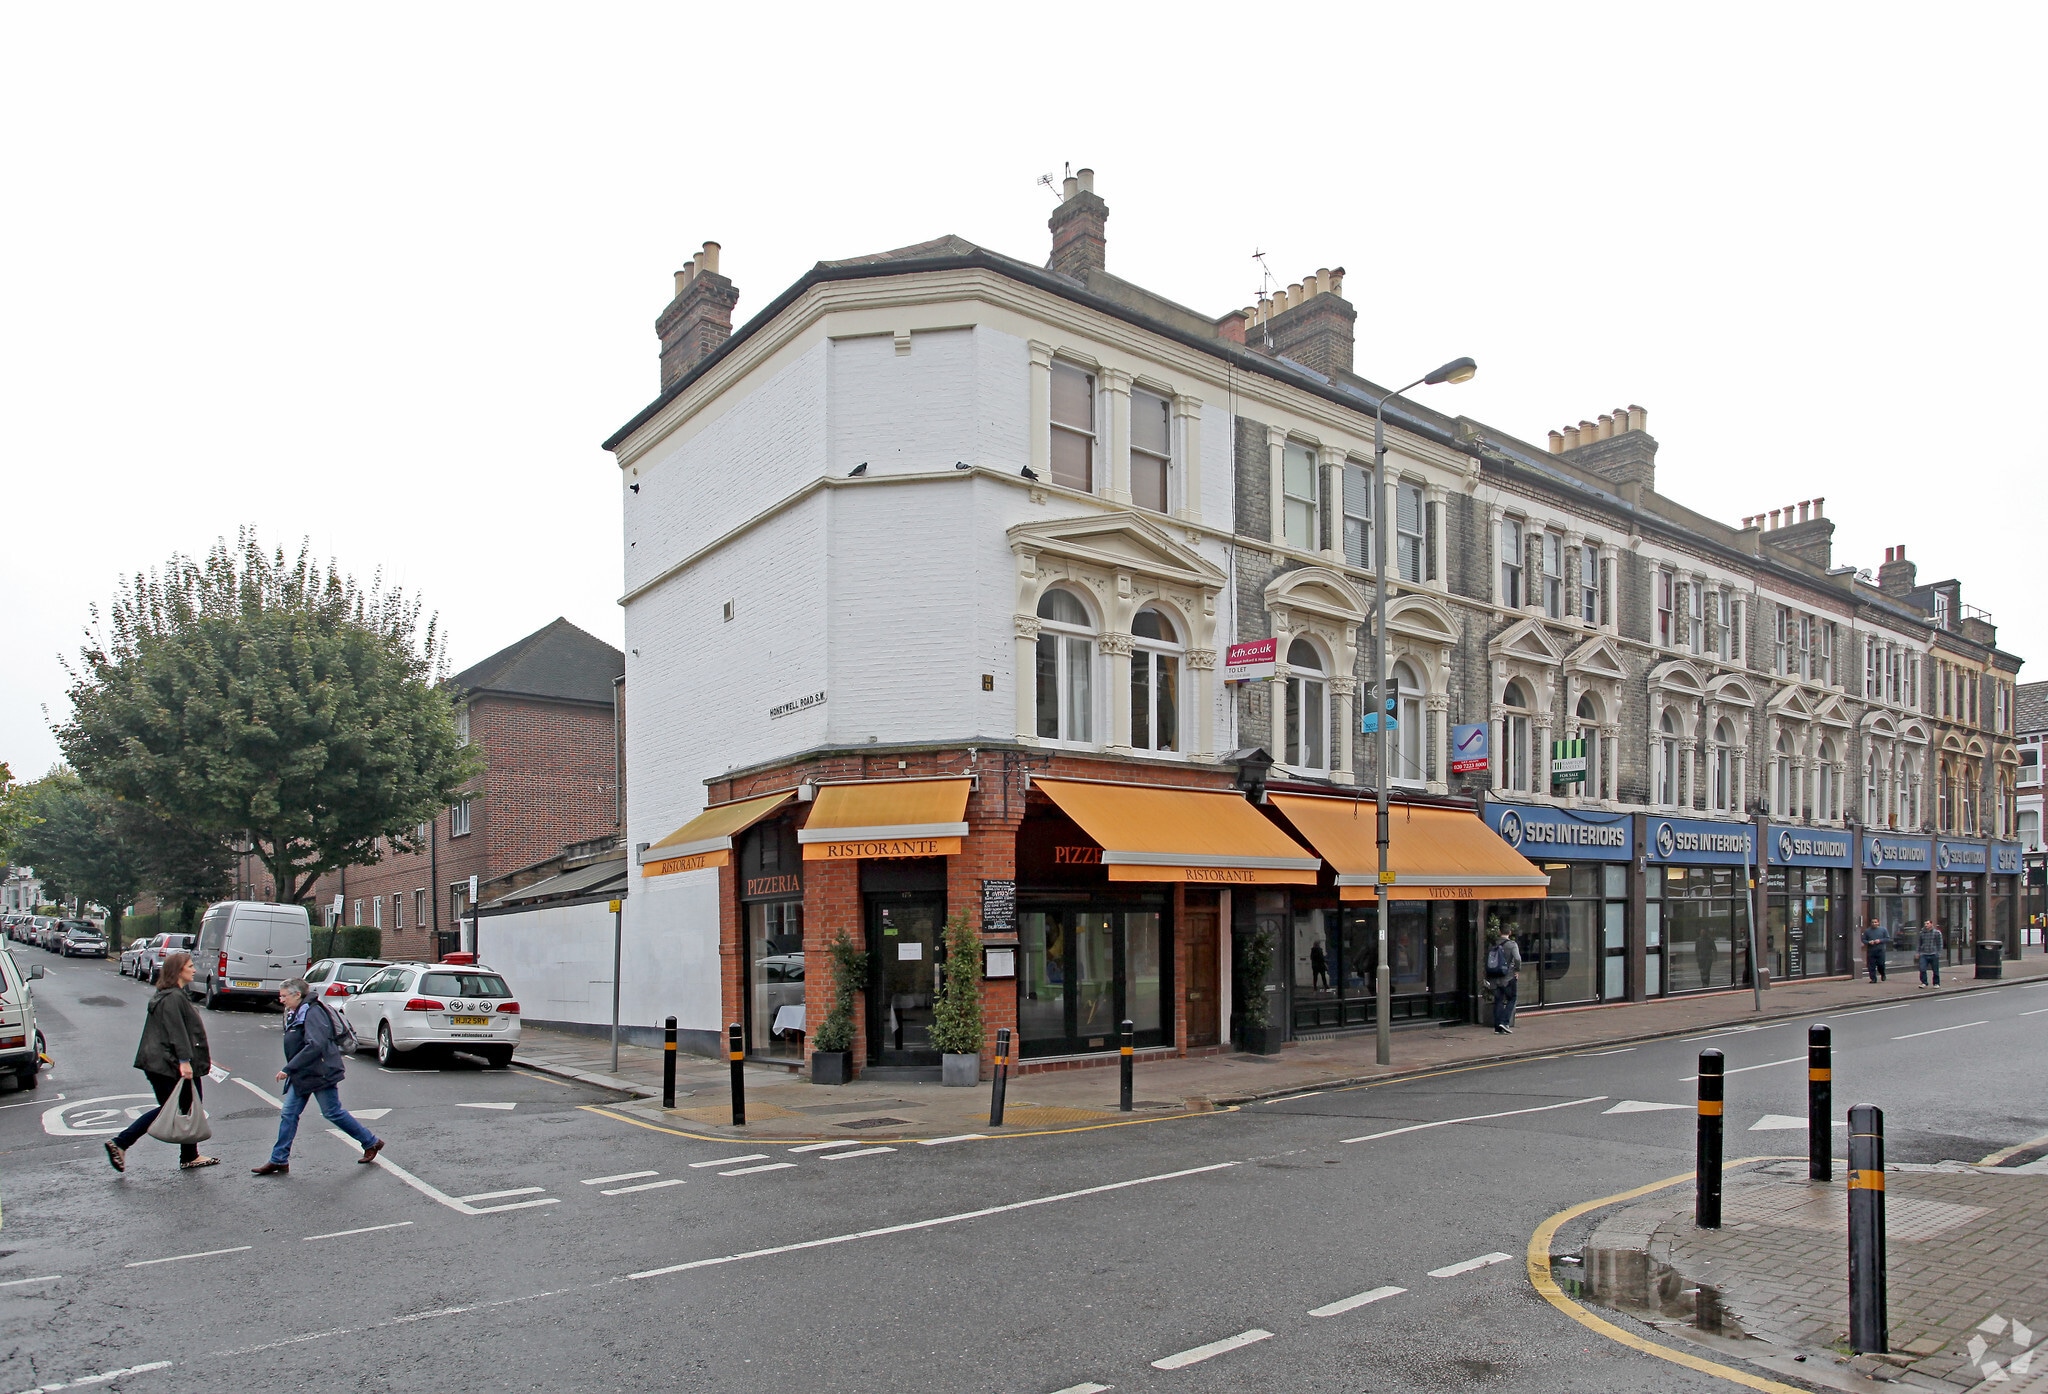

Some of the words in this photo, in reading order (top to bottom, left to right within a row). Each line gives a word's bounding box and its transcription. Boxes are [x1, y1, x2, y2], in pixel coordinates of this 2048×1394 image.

[1231, 643, 1272, 658] kfh.co.uk
[769, 700, 799, 717] HONEYWELL
[800, 695, 814, 708] ROAD
[1525, 822, 1555, 843] SDS
[1556, 823, 1625, 846] INTERIORS
[1676, 832, 1699, 850] SDS
[828, 840, 938, 857] RISTORANTE
[1794, 838, 1812, 855] SDS
[1813, 840, 1847, 857] LONDON
[1883, 847, 1897, 860] SDS
[1898, 847, 1926, 861] LONDON
[661, 856, 706, 874] RISTORANTE
[1950, 852, 1962, 864] SDS
[1963, 851, 1986, 864] LONDON
[1998, 850, 2017, 870] SDS
[1185, 869, 1255, 882] RISTORANTE
[747, 874, 800, 896] PIZZERIA
[1429, 887, 1456, 898] VITO'S
[1458, 887, 1473, 898] BAR
